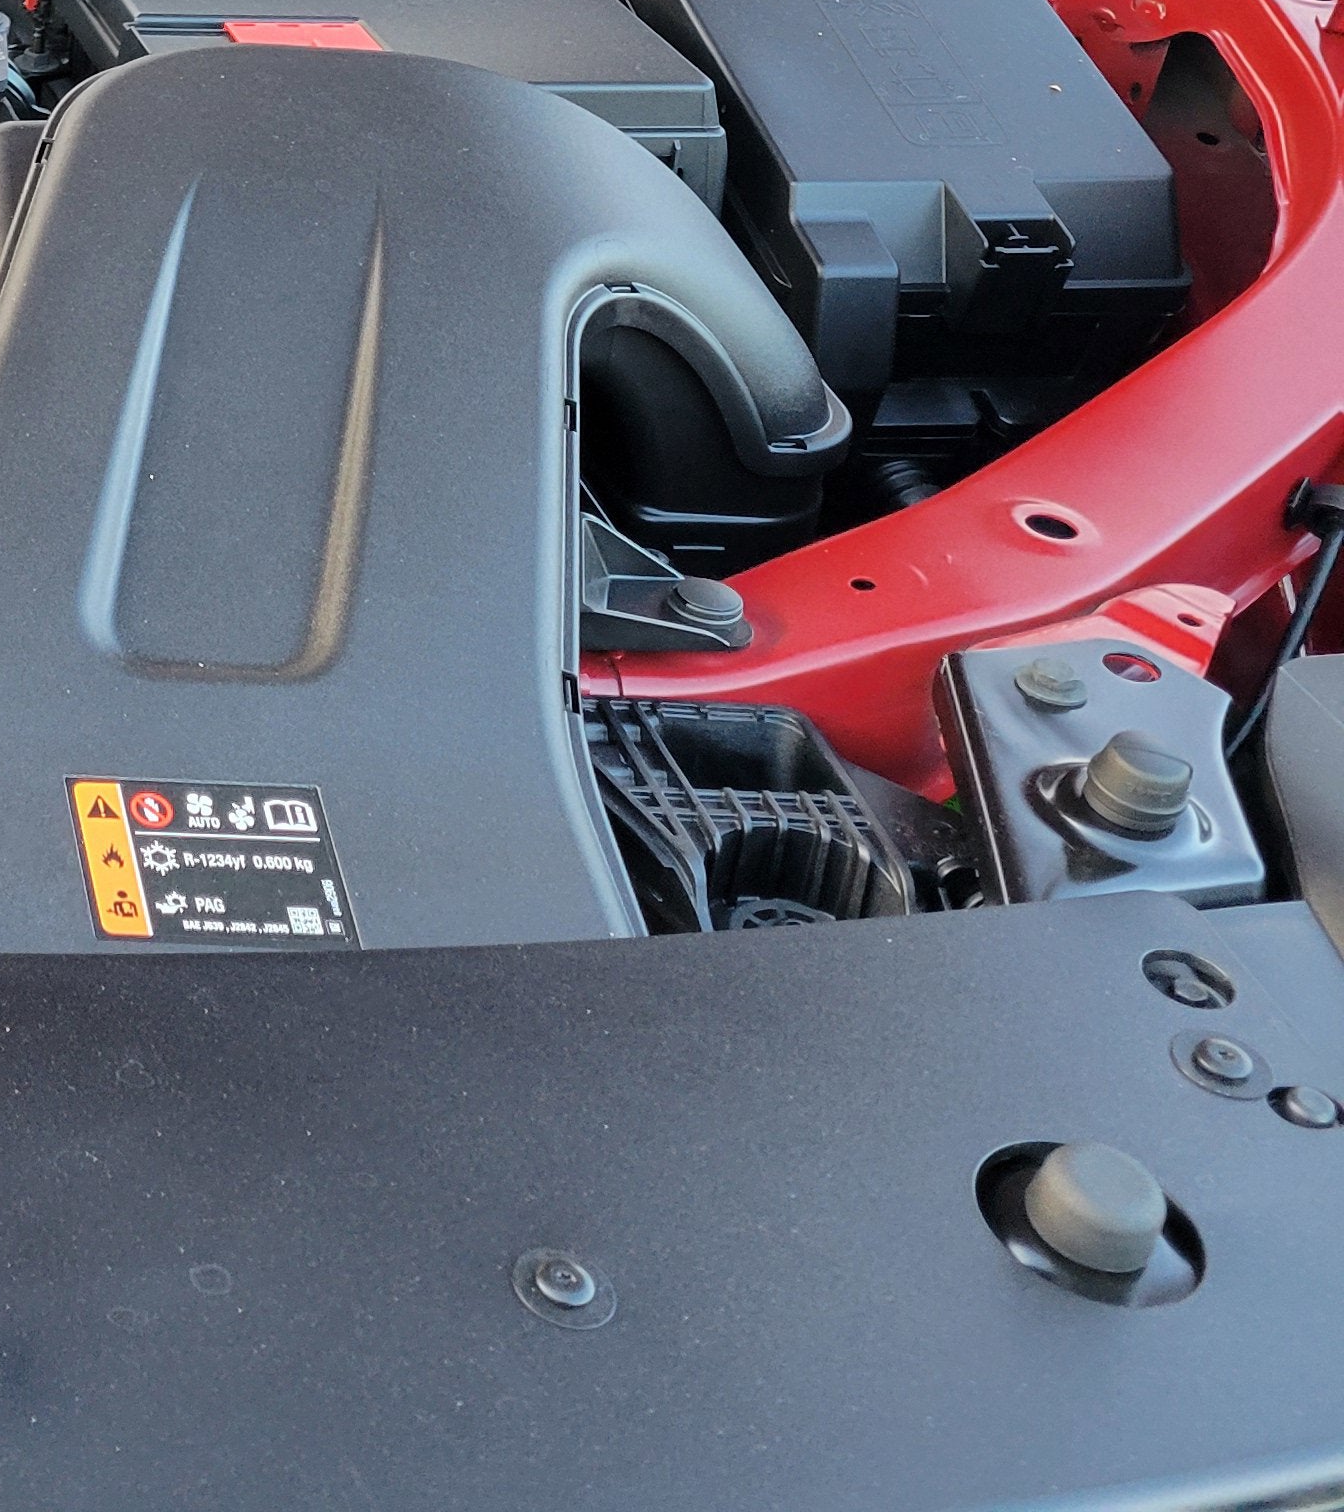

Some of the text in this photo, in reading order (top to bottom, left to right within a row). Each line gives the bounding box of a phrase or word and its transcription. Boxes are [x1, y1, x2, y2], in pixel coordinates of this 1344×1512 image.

[188, 816, 221, 830] AUTO
[183, 853, 314, 874] R-1234yf 0.600 kg
[194, 896, 226, 914] PAG
